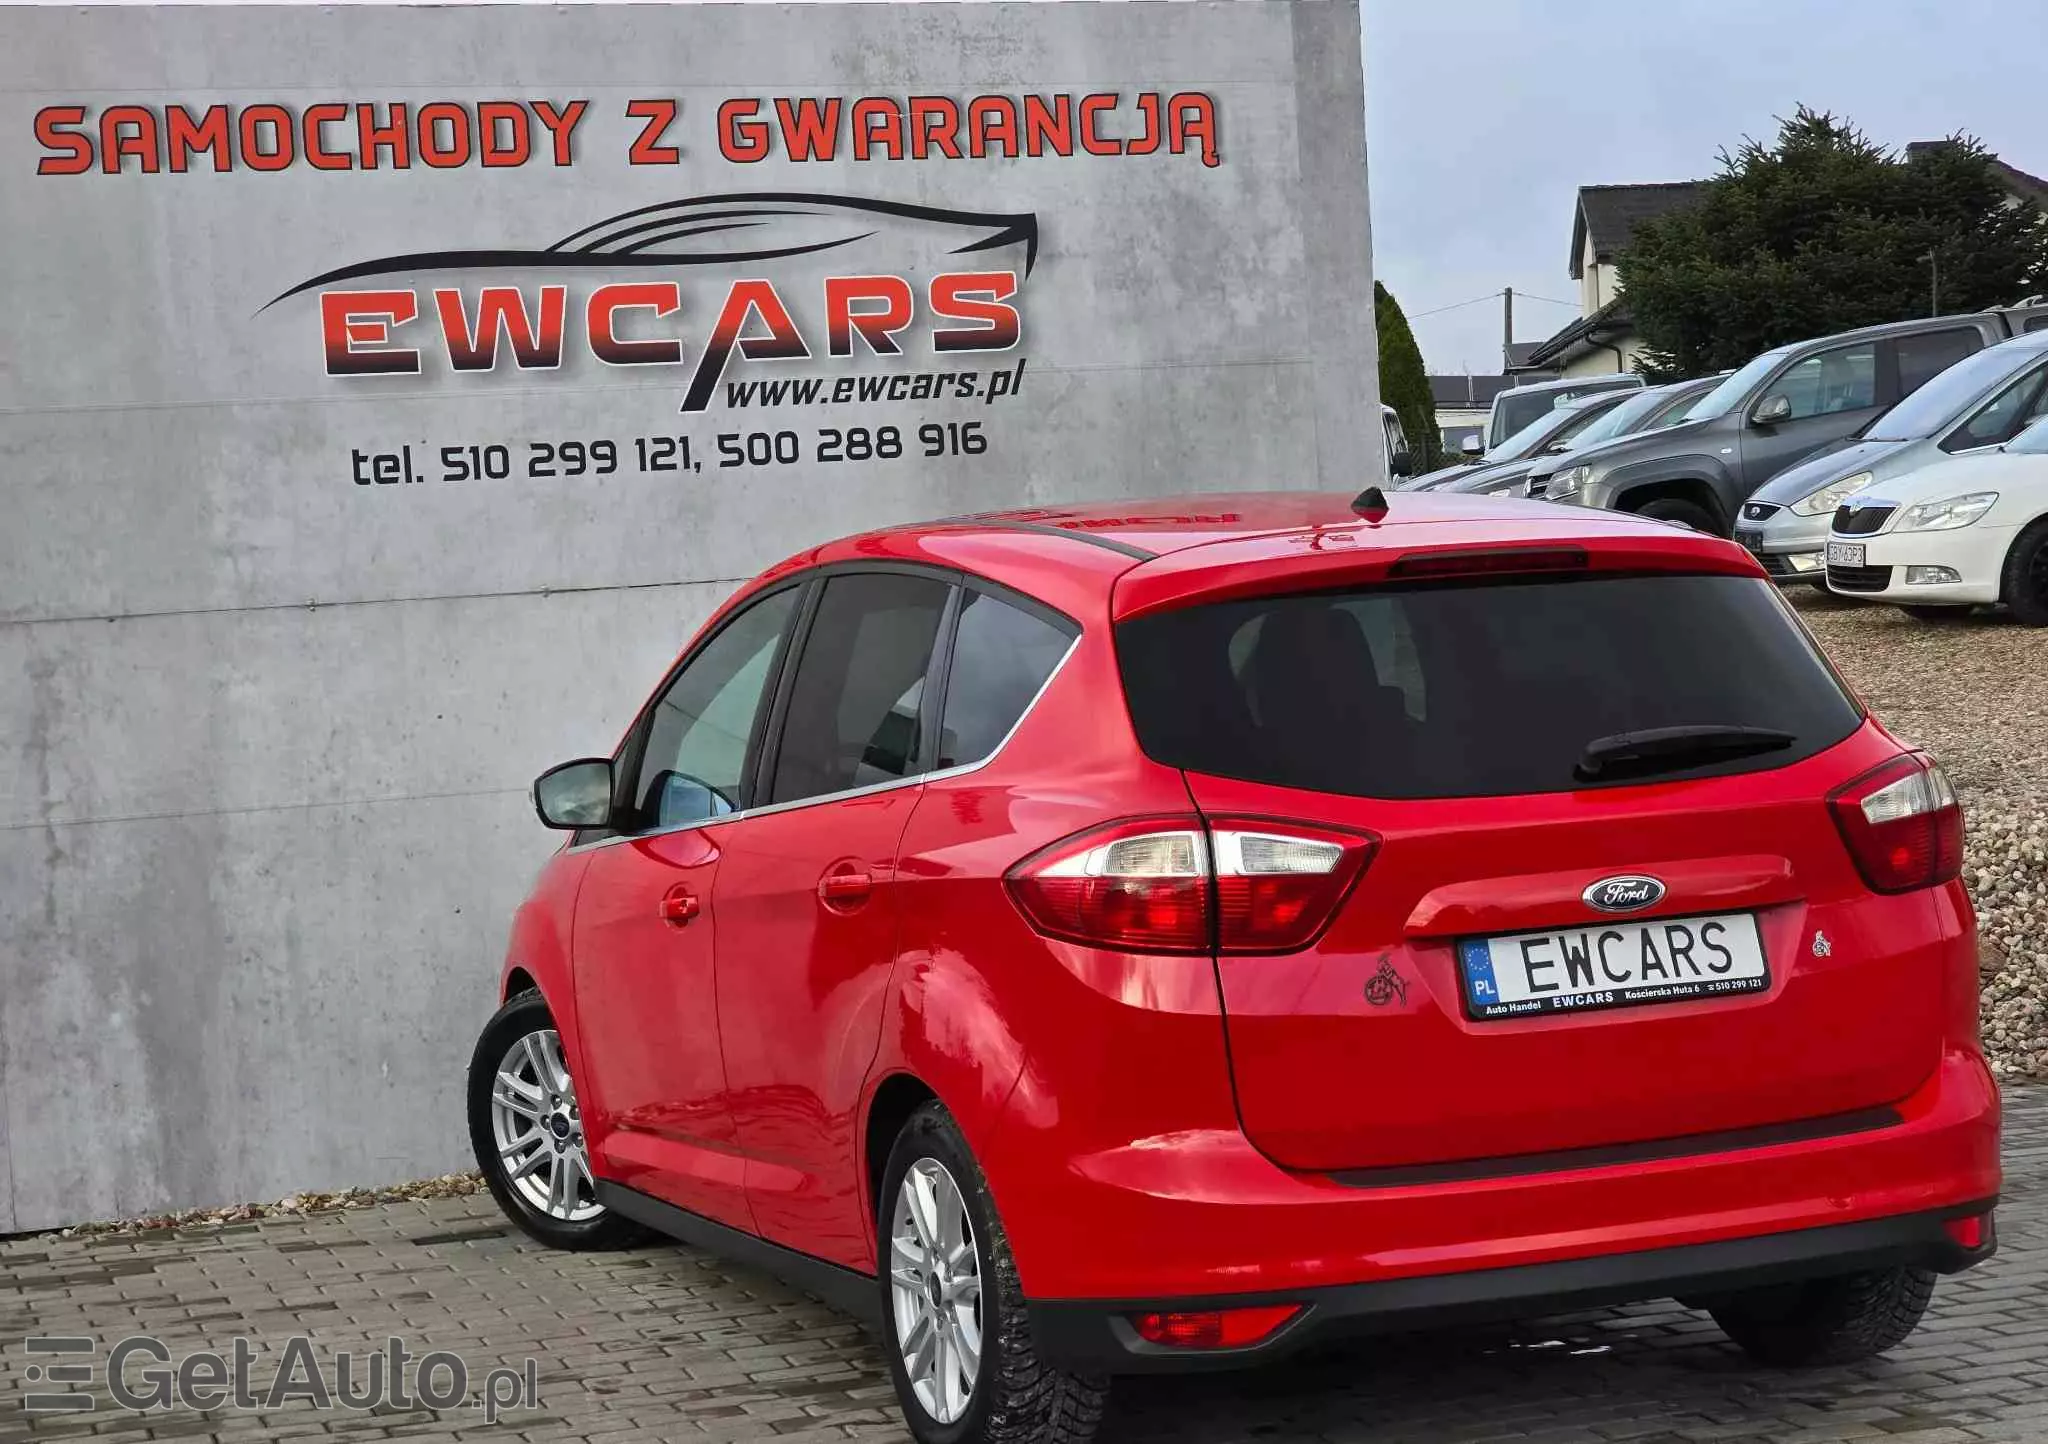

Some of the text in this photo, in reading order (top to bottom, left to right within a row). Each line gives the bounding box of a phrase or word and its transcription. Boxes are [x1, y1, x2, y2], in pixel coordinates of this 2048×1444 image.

[34, 91, 1221, 175] SAMOCHODY Z GWARANCJĄ
[319, 271, 1021, 413] EWCARS
[726, 358, 1026, 408] www.ewcars.pl
[351, 420, 988, 485] tel. 510 299 121, 500 288 916
[1604, 881, 1649, 904] Ford
[1520, 921, 1733, 993] EWCARS
[1474, 980, 1495, 996] PL
[1674, 984, 1693, 995] Huta
[1694, 984, 1700, 993] 6
[1715, 979, 1762, 991] 510 299 121
[1486, 1001, 1541, 1015] Auto Handel
[1553, 992, 1614, 1008] EWCARS
